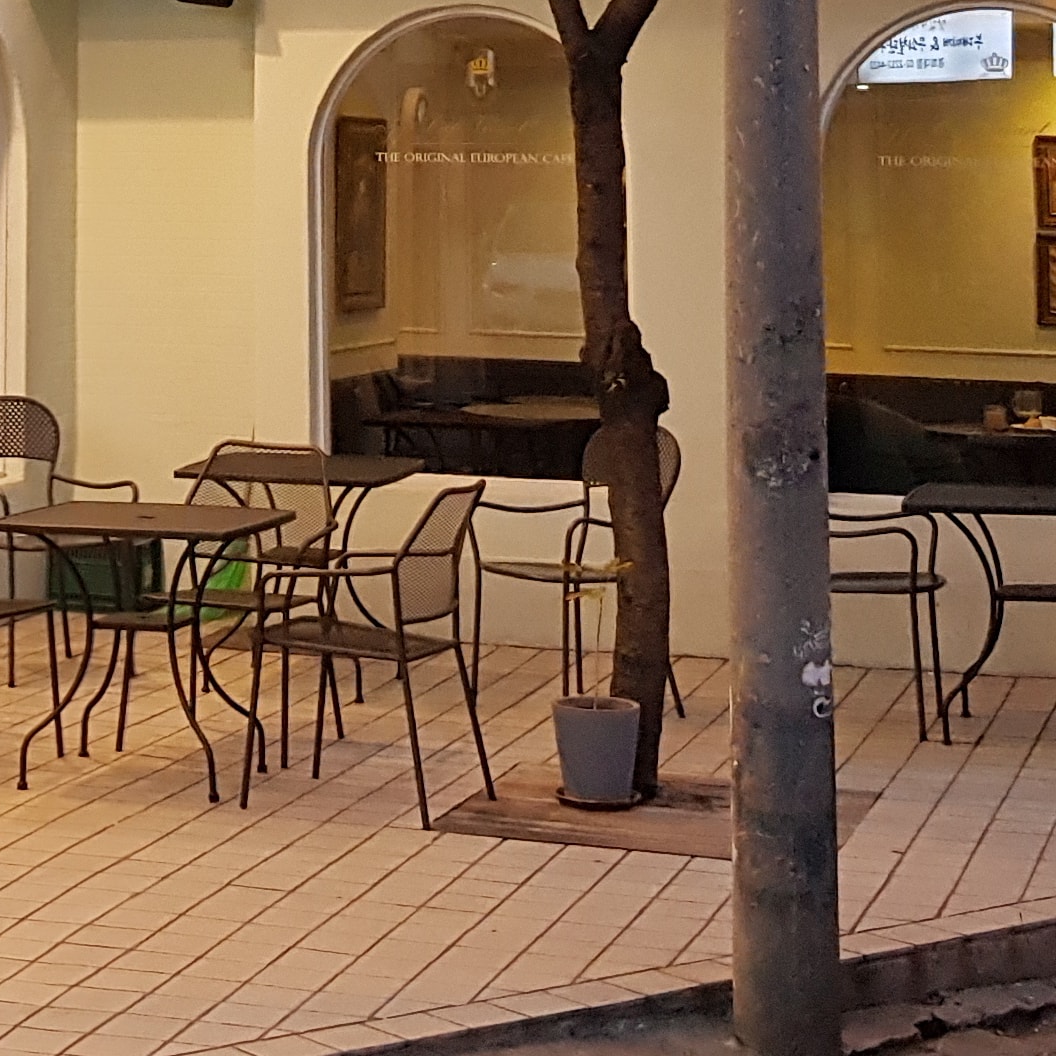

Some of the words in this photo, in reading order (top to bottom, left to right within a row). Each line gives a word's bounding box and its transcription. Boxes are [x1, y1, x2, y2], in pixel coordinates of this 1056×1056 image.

[374, 151, 400, 163] THE
[404, 151, 467, 164] ORIGINAL
[470, 152, 538, 164] EUROPEAN
[877, 155, 904, 167] THE
